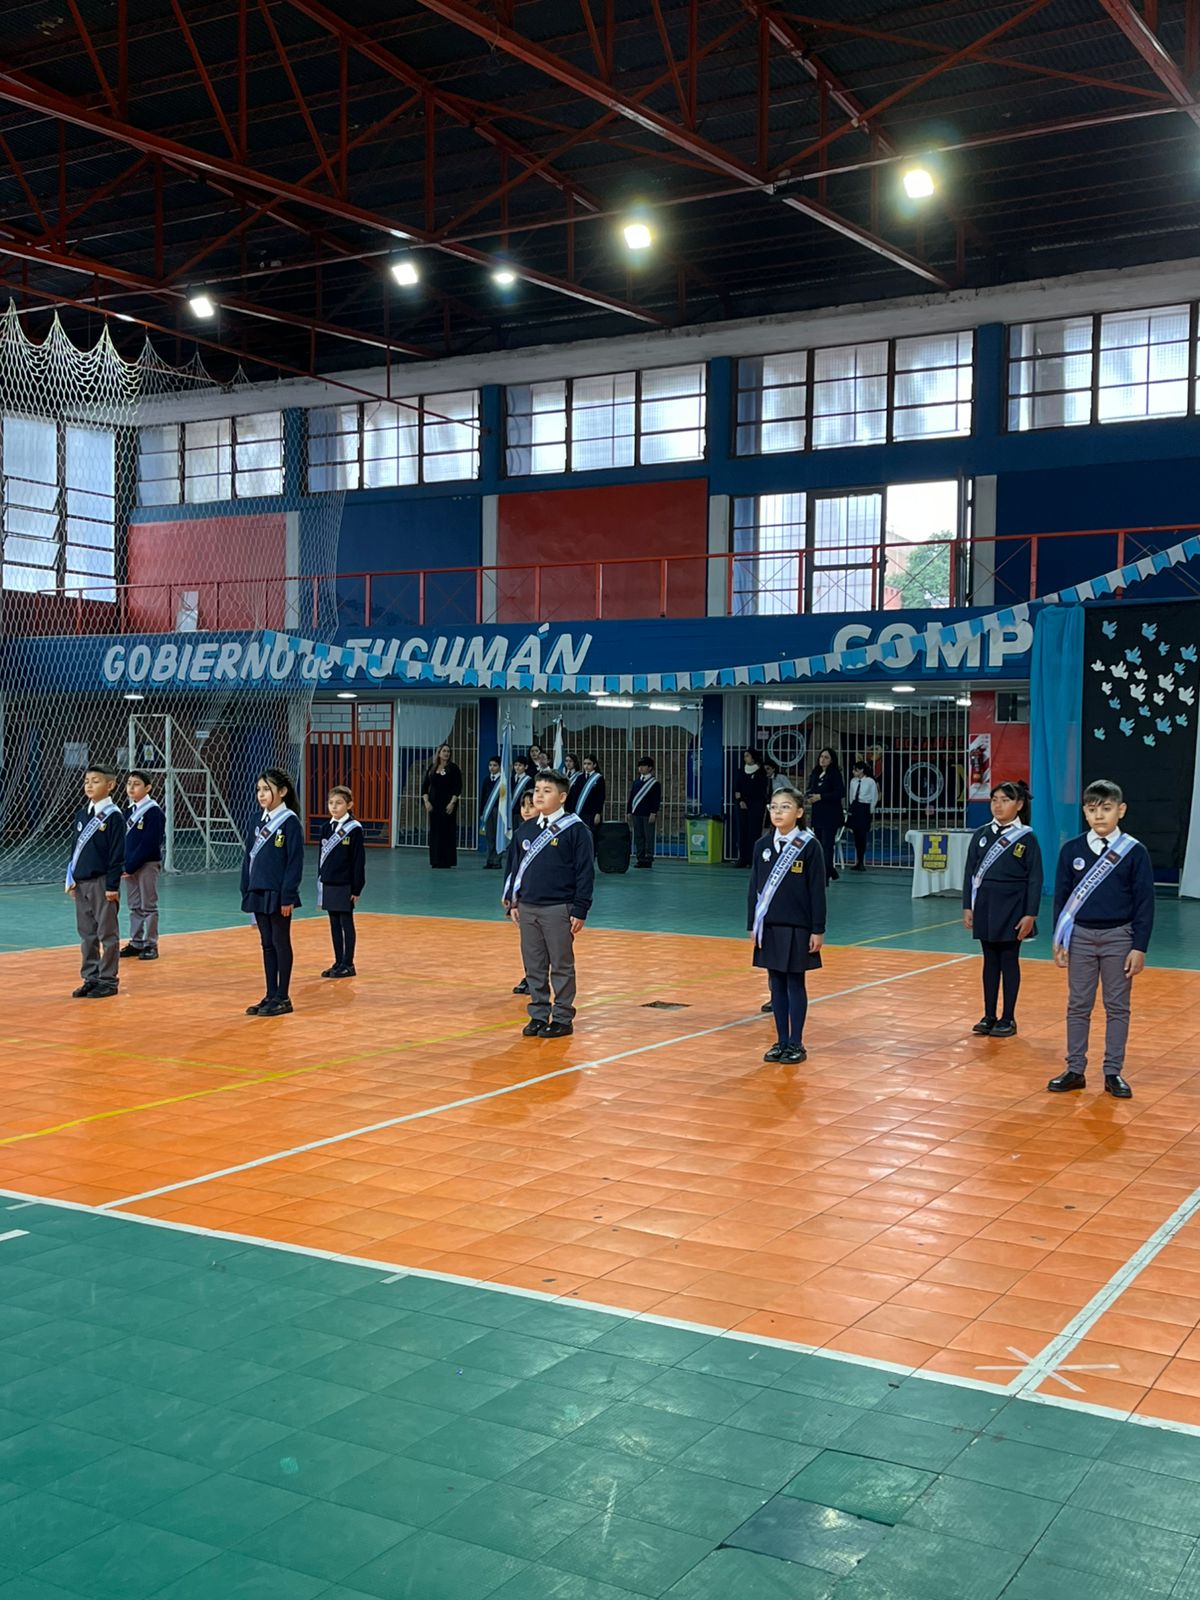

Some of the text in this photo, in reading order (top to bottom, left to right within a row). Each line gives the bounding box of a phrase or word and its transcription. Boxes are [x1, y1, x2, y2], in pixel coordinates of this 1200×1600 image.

[103, 642, 295, 682] GOBIERNO
[345, 622, 593, 679] TUCUMÁN
[833, 620, 1034, 669] COMP
